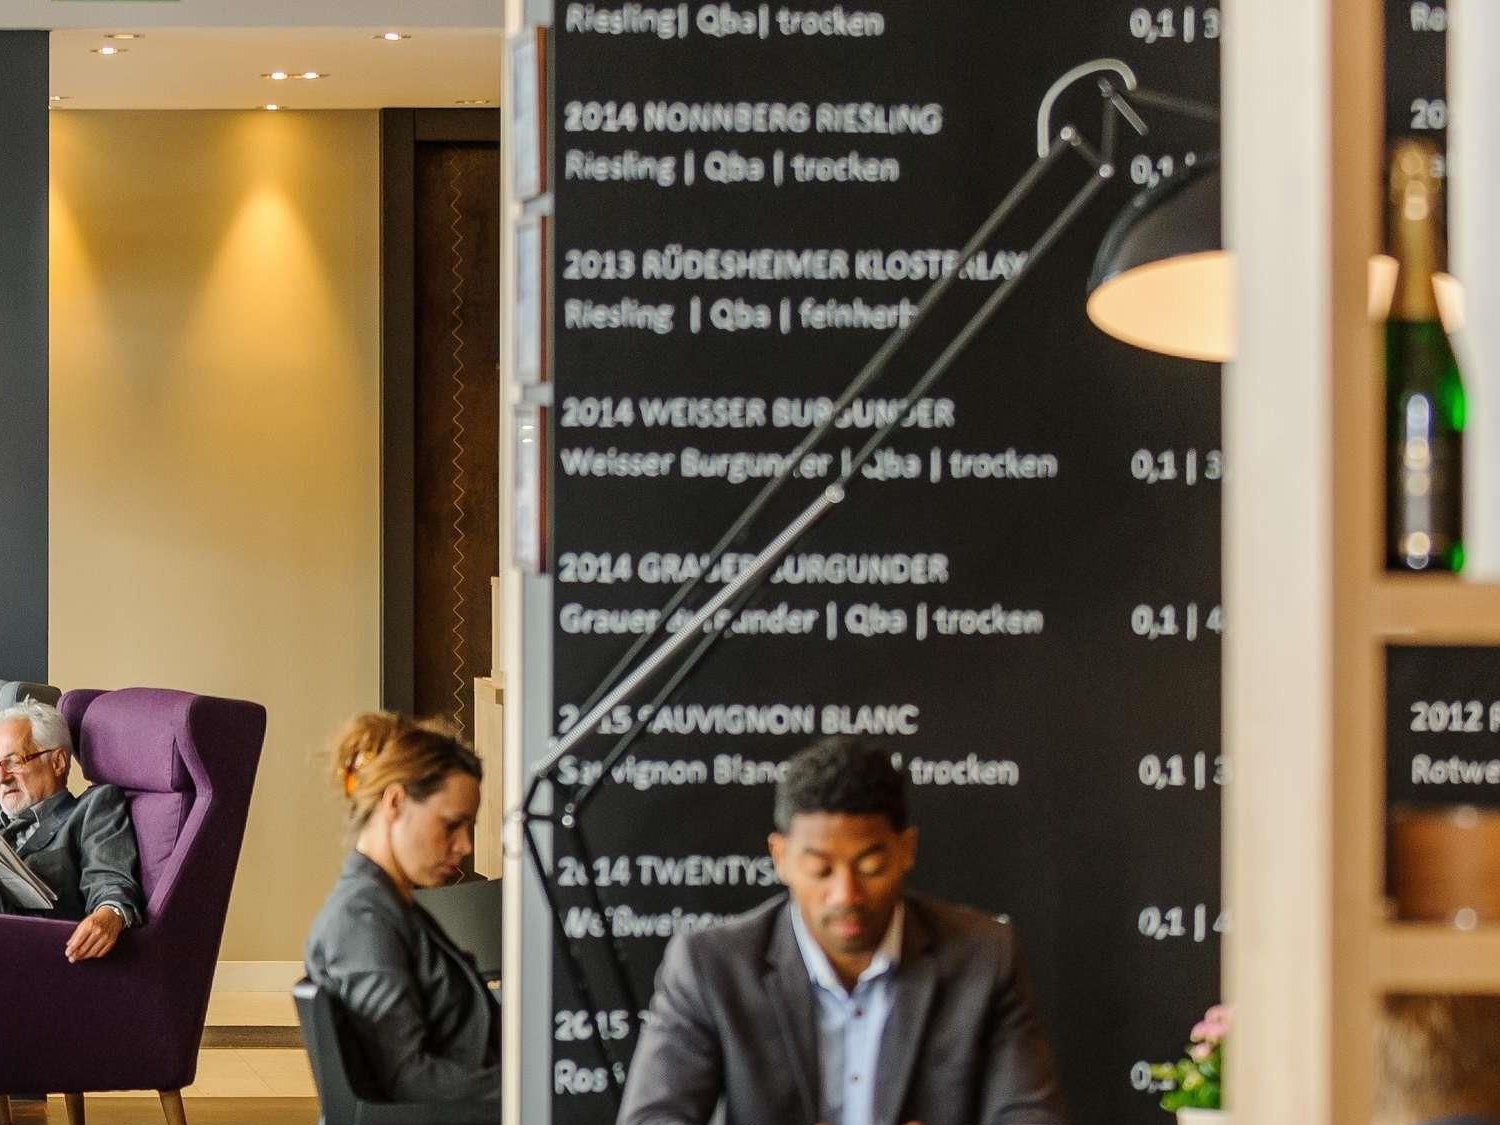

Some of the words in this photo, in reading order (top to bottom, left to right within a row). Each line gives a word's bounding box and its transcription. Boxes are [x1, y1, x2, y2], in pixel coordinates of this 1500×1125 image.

[776, 3, 886, 37] trocken
[1129, 7, 1176, 44] 0,1
[564, 100, 638, 133] 2014
[643, 101, 811, 133] NONNBERG
[816, 102, 944, 136] RIESLING
[565, 148, 677, 187] Riesling
[703, 149, 765, 184] Qba
[790, 150, 901, 183] trocken
[563, 248, 636, 280] 2013
[642, 243, 850, 280] RÜDESHEIMER
[563, 296, 675, 335] Riesling
[709, 297, 772, 332] Qba
[560, 396, 636, 428] 2014
[639, 396, 767, 429] WEISSER
[559, 446, 676, 477] Weisser
[948, 446, 1060, 479] trocken
[1130, 448, 1178, 485] 0,1
[558, 551, 633, 584] 2014
[771, 552, 950, 585] URGUNDER
[844, 602, 908, 638] Qba
[932, 602, 1044, 635] trocken
[1130, 603, 1179, 640] 0,1
[821, 703, 920, 735] BLANC
[1410, 700, 1484, 733] 2012
[908, 752, 1020, 786] trocken
[1138, 753, 1186, 790] 0,1
[1137, 905, 1186, 941] 0,1
